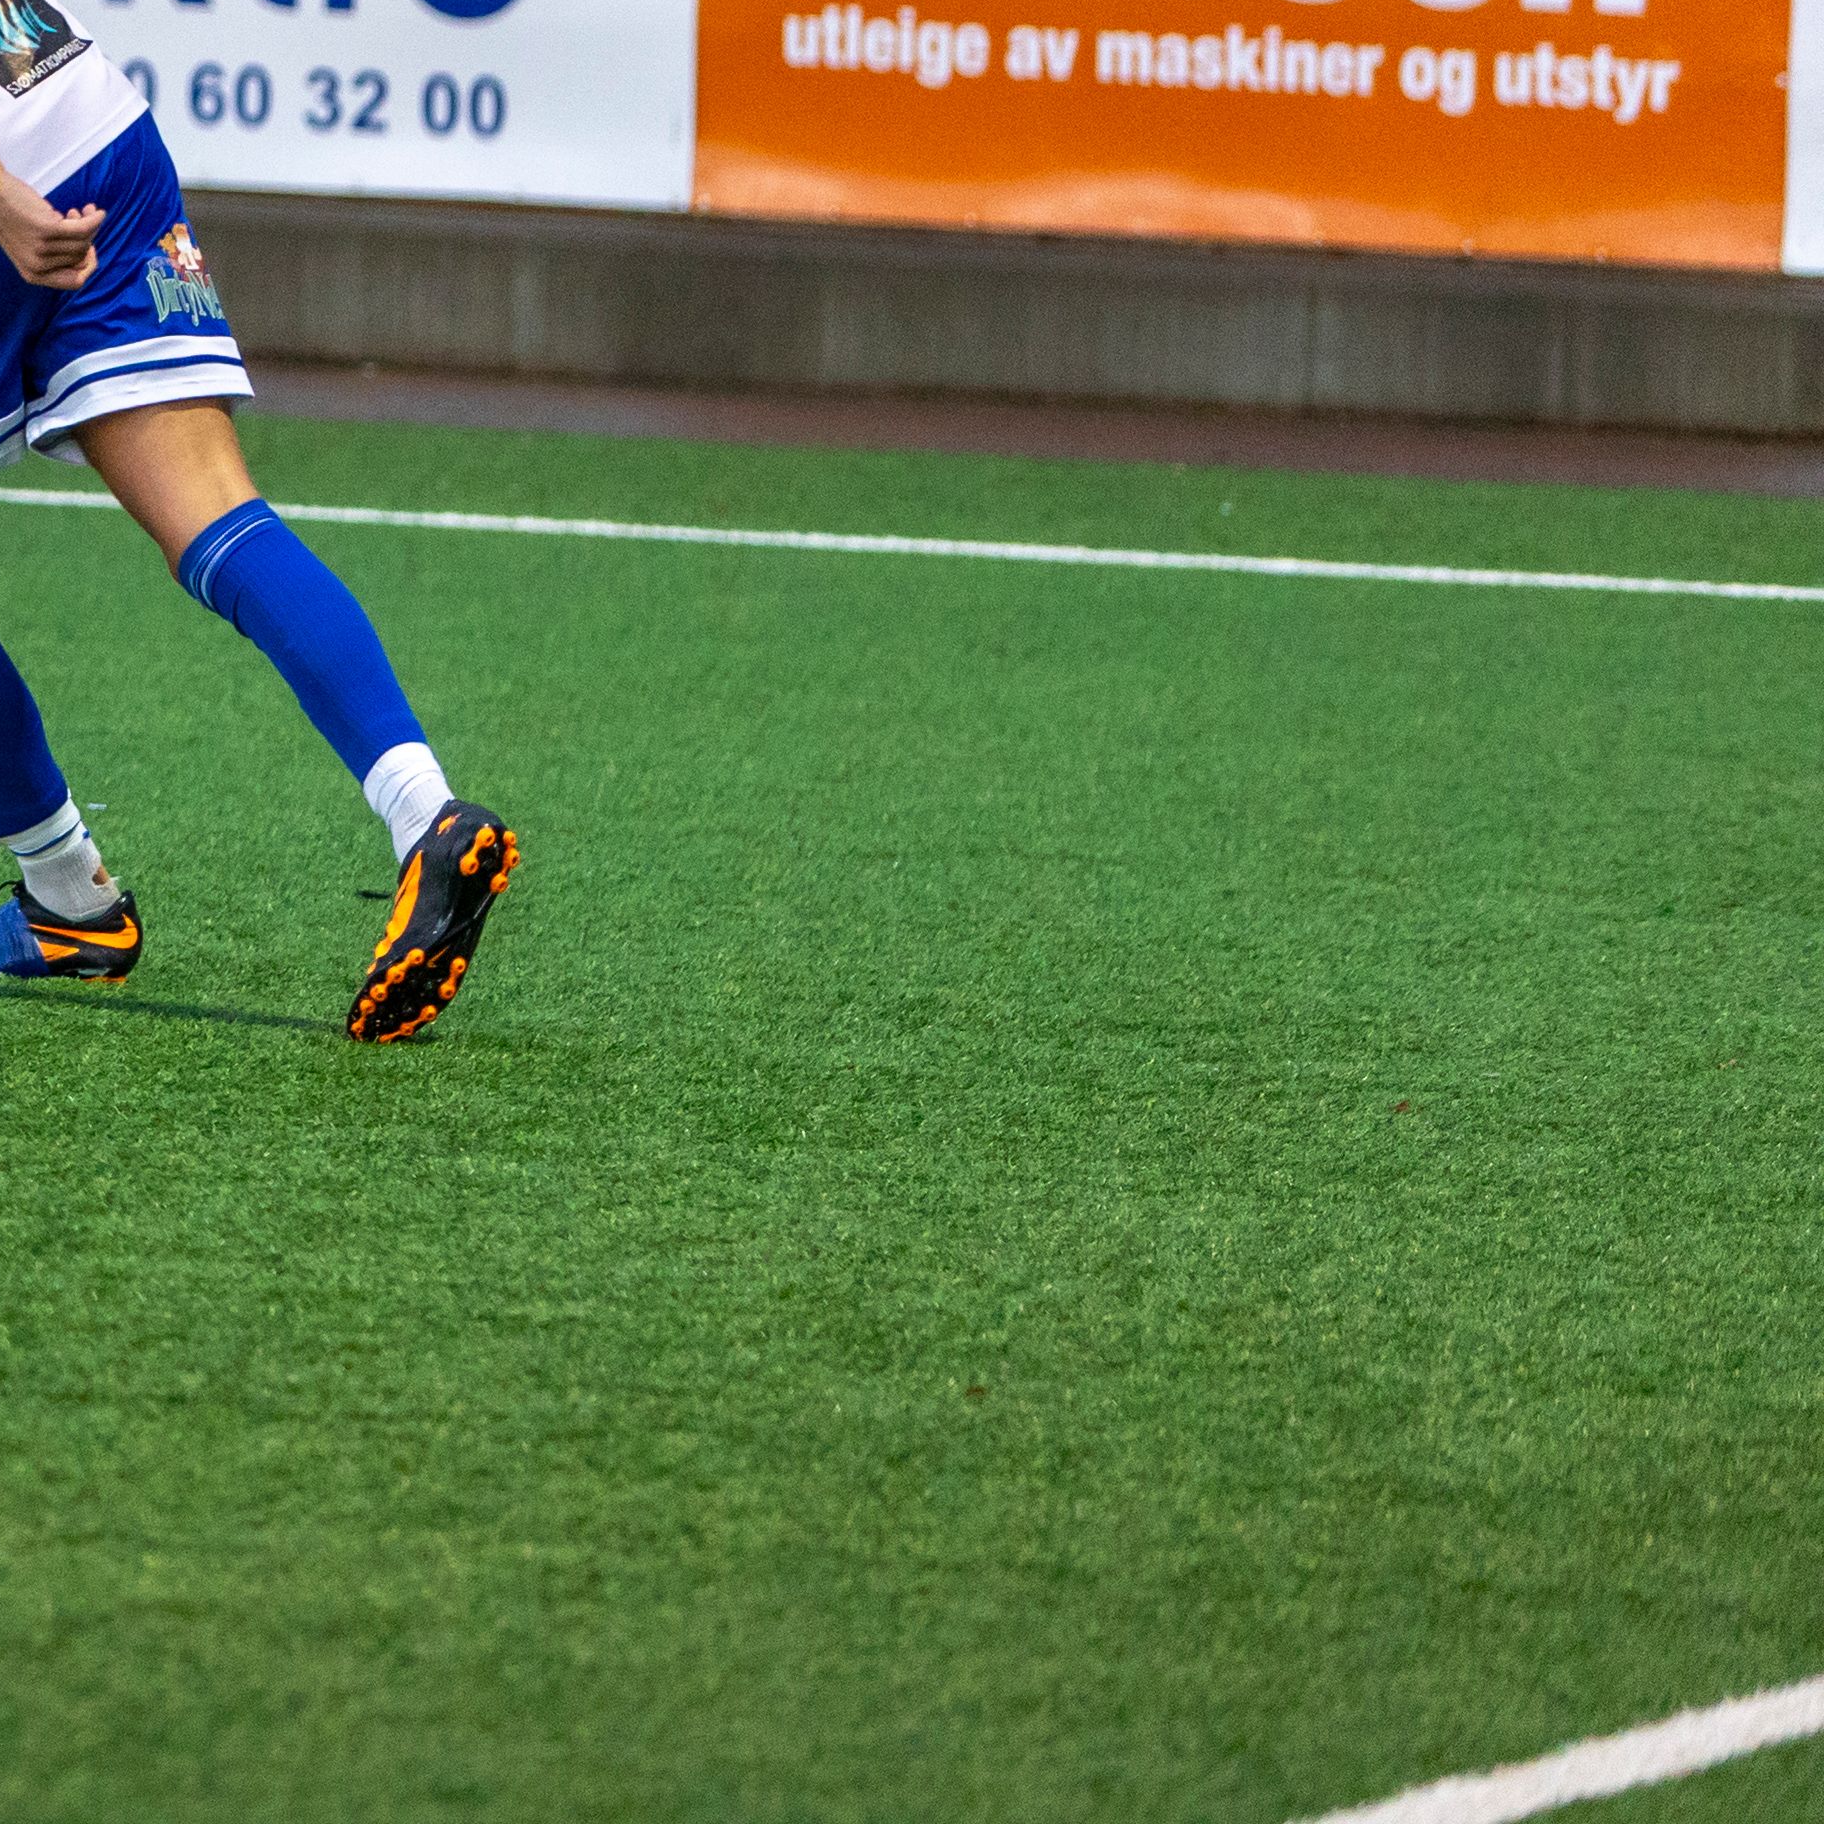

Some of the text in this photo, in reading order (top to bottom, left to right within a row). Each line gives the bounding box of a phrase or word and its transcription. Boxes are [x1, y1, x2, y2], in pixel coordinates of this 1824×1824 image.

[188, 62, 272, 127] 60
[305, 67, 389, 133] 32
[421, 72, 507, 138] 00
[784, 5, 1681, 124] utleige av maskiner og utstyr
